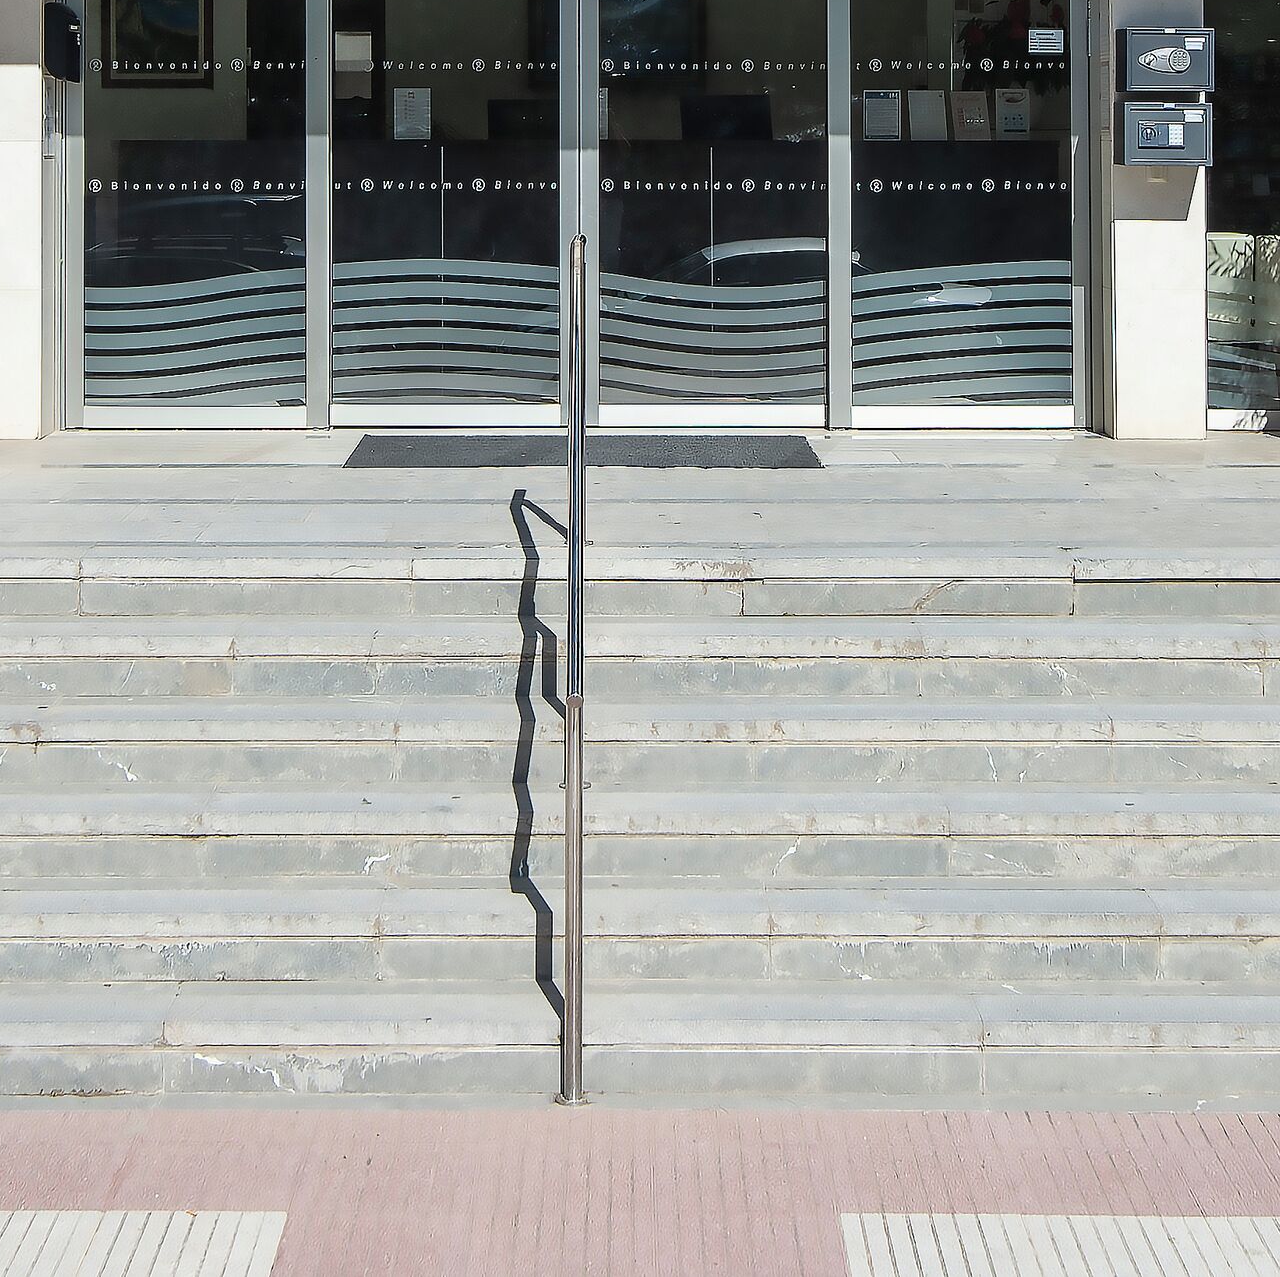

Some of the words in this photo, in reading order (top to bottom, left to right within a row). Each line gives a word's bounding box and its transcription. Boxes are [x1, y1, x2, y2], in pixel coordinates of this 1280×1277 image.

[382, 60, 464, 70] Welcome
[891, 60, 972, 70] Welcome
[382, 181, 464, 190] Welcome
[891, 181, 973, 191] Welcome
